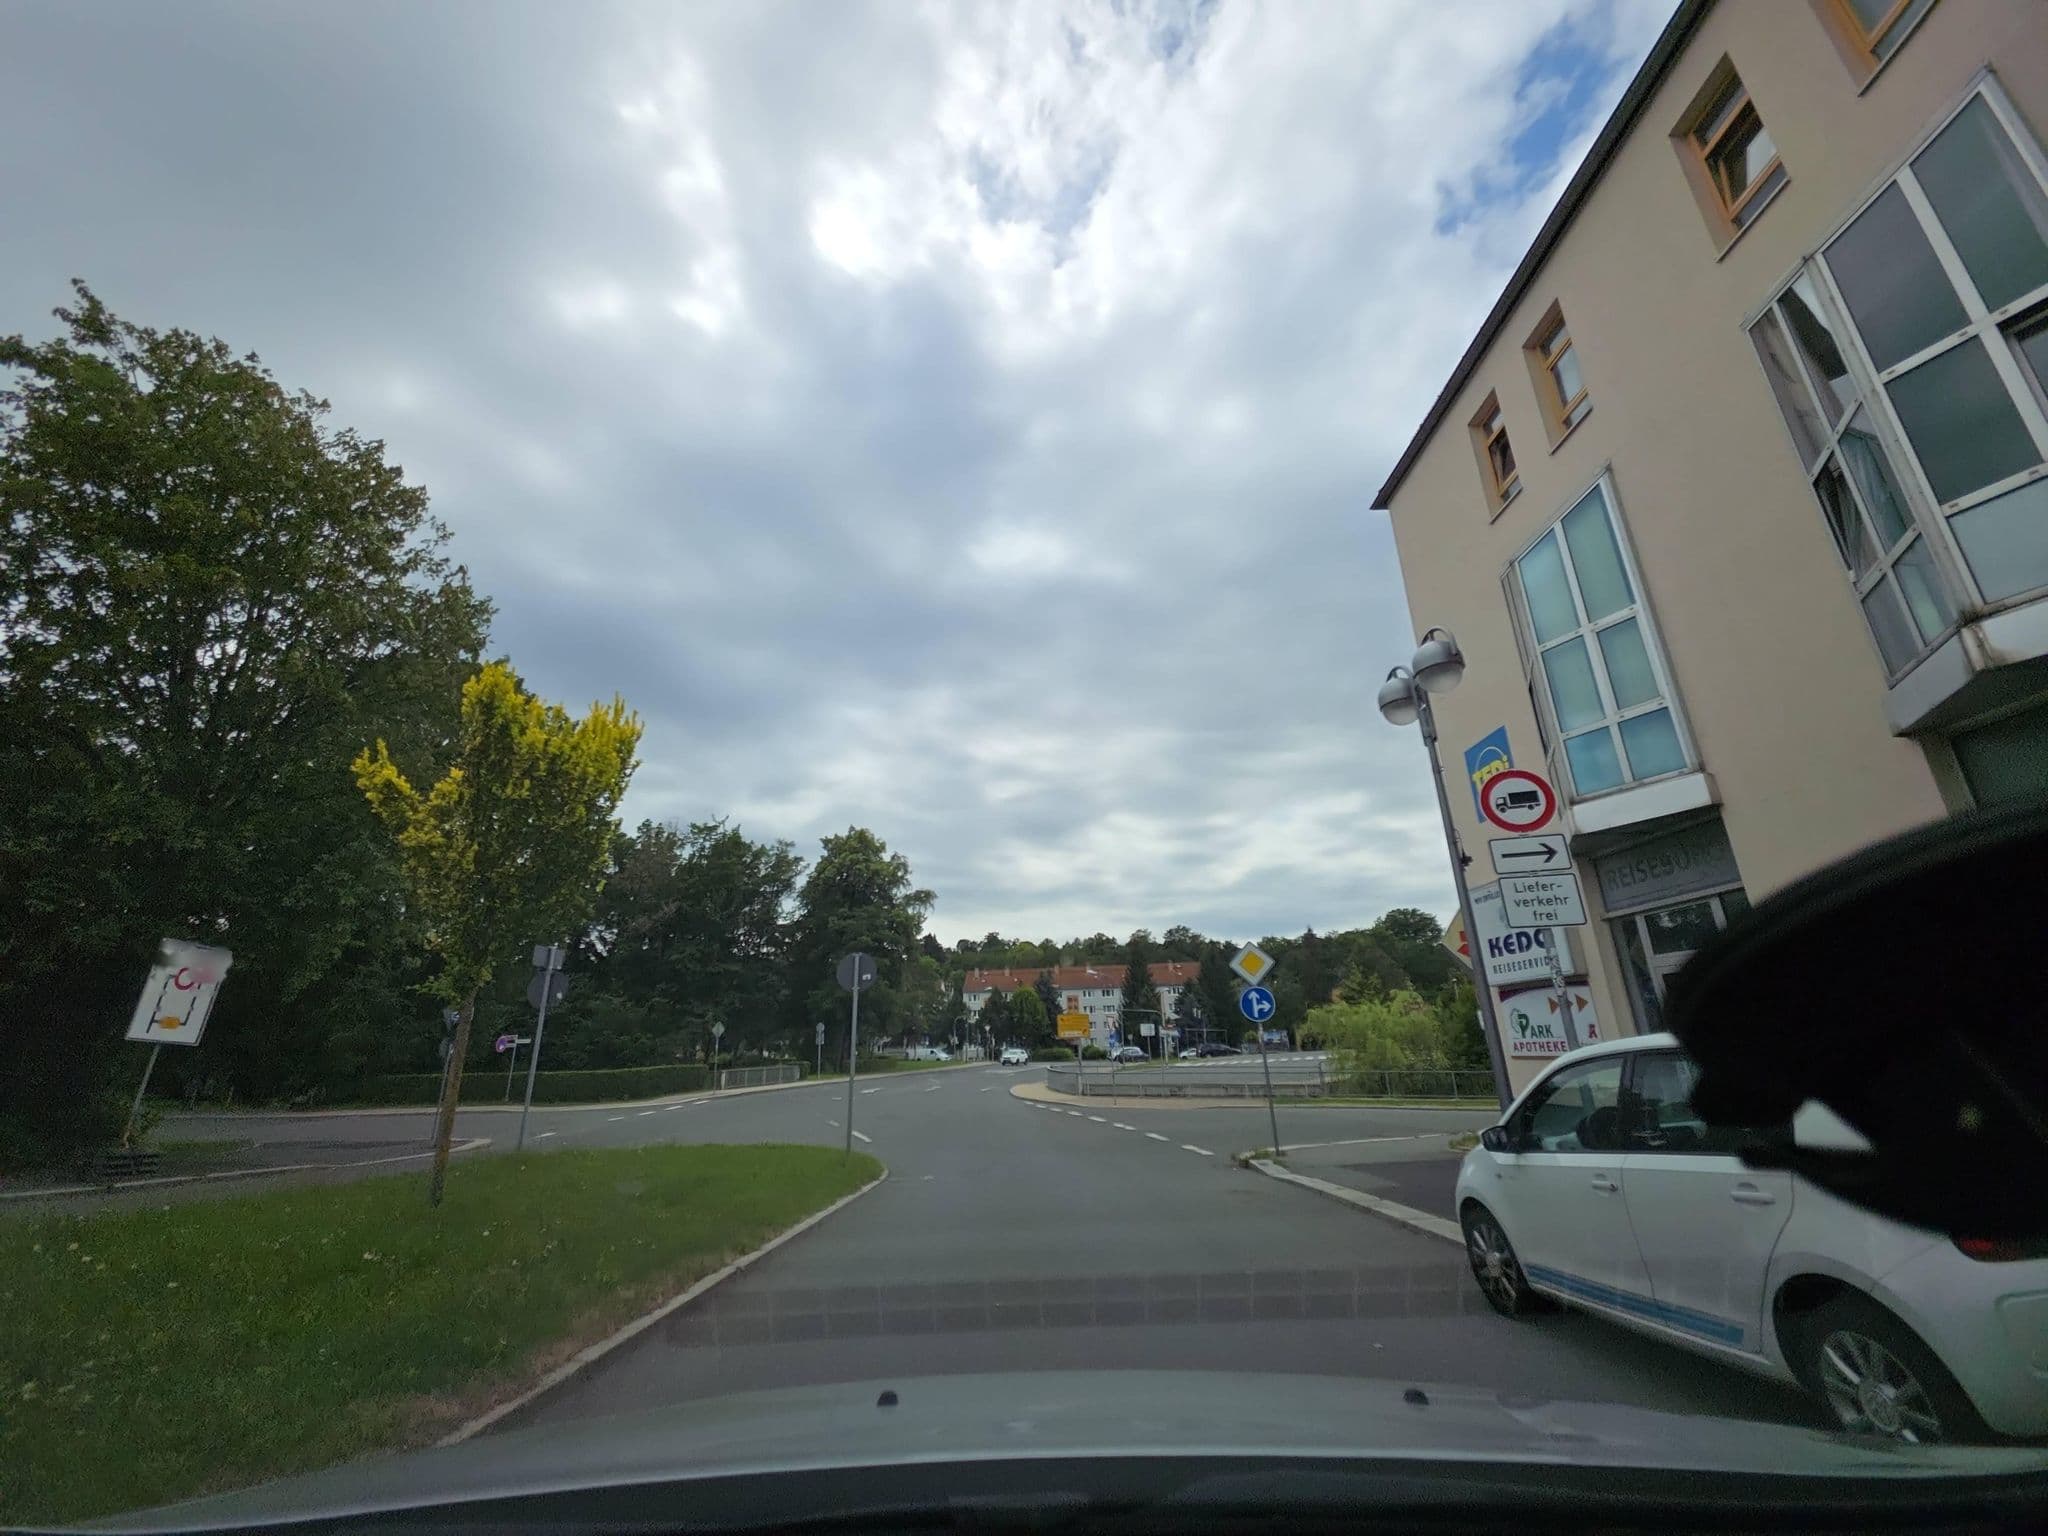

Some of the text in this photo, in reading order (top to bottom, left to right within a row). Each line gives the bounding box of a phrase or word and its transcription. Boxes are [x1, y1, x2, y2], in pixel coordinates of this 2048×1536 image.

[1513, 881, 1563, 893] Liefer-
[1514, 895, 1570, 907] verkehr
[1533, 910, 1558, 921] frei
[1493, 955, 1553, 975] REISESERVIC
[1518, 1013, 1553, 1039] PARK
[1513, 1041, 1567, 1052] APOTHEKE
